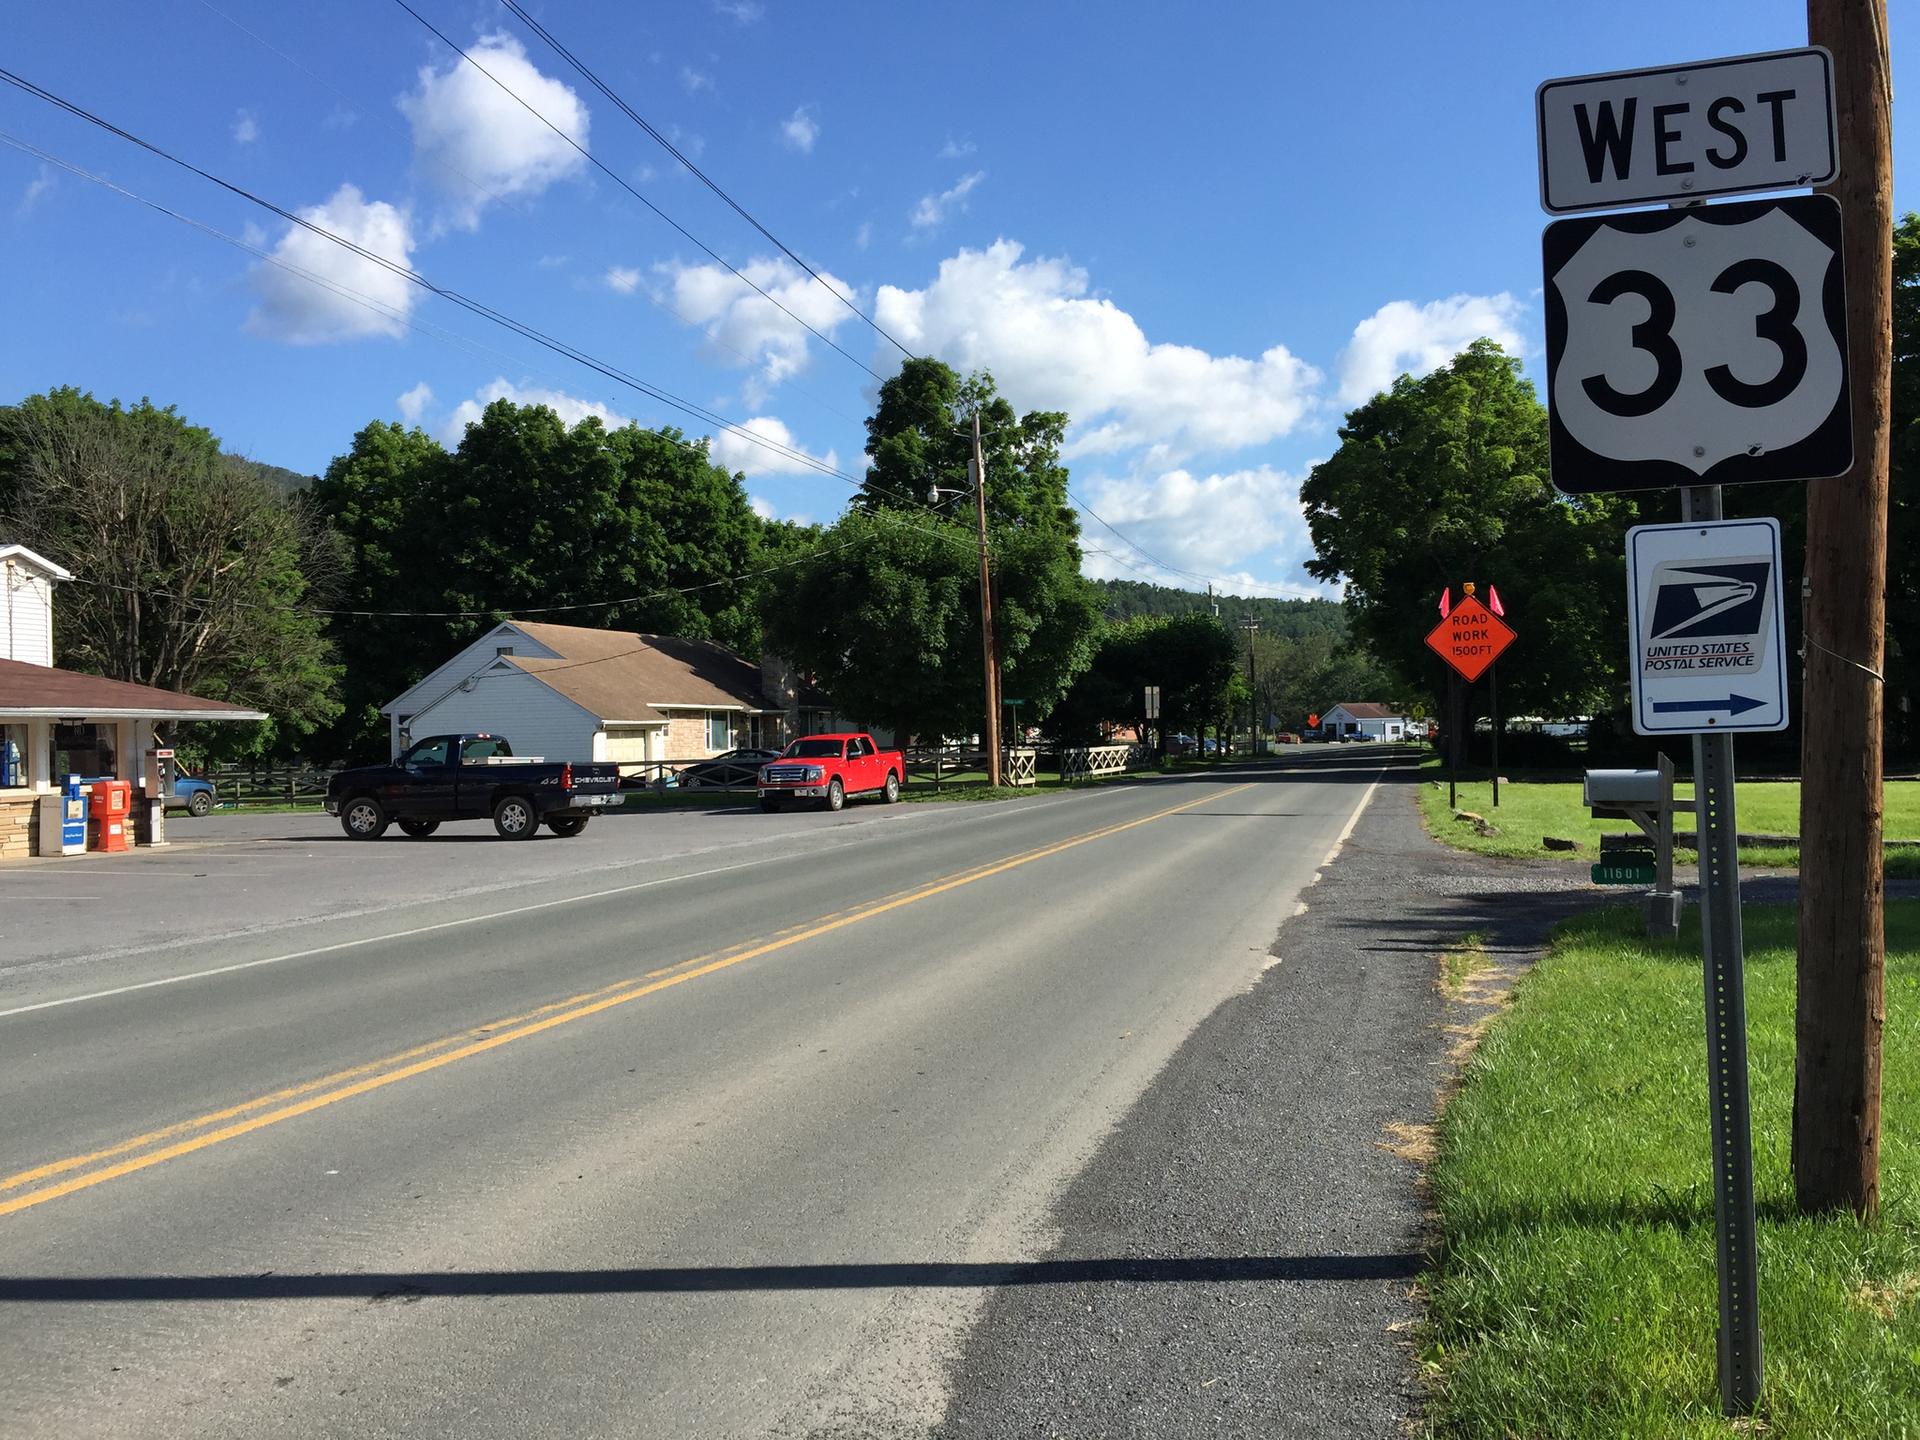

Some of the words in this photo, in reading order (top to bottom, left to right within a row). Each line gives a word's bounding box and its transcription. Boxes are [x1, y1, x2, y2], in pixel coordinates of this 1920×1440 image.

[1573, 89, 1797, 184] WEST
[1581, 258, 1808, 418] 33
[1453, 613, 1488, 626] ROAD
[1453, 630, 1489, 642] WORK
[1647, 644, 1700, 657] UNITED
[1701, 642, 1750, 655] STATES
[1645, 659, 1696, 671] POSTAL
[1698, 656, 1754, 668] SERVICE
[574, 776, 616, 784] CHEVROLET
[1603, 867, 1640, 879] 11601
